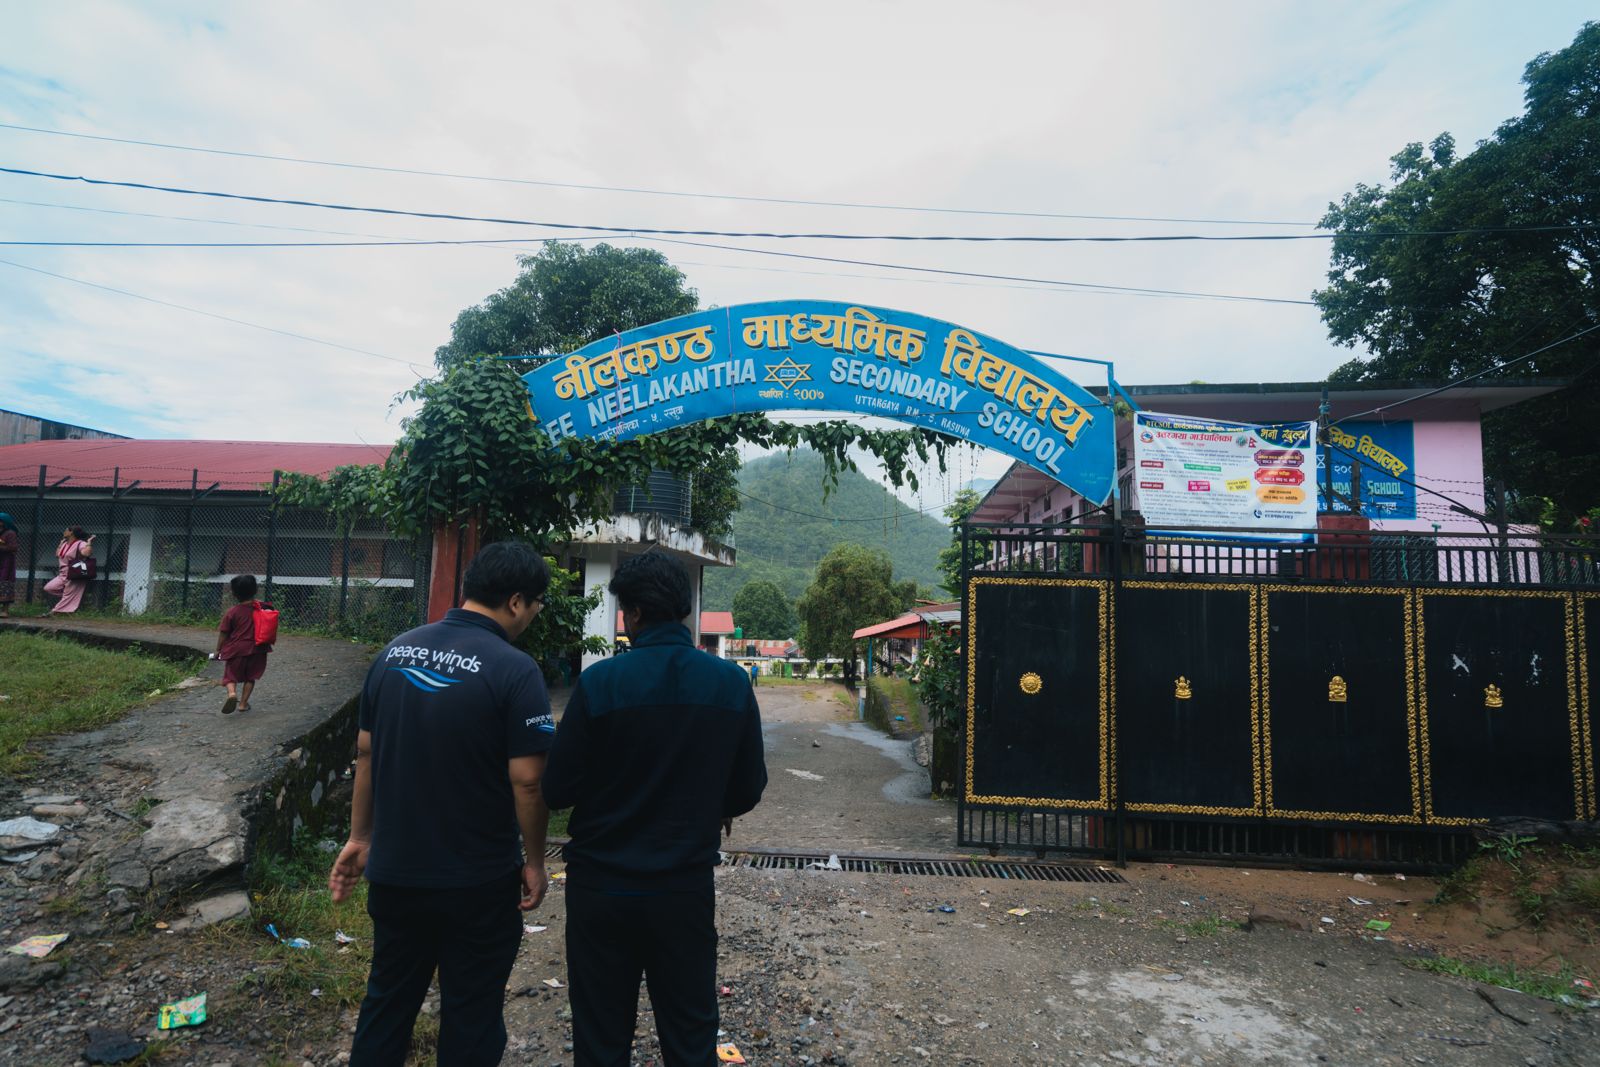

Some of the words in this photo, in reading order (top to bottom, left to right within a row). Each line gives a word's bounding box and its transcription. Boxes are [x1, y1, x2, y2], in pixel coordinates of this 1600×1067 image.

[552, 325, 714, 401] नीलकण्ठ
[742, 306, 927, 363] माध्यमिक
[943, 328, 1094, 443] विद्यालय
[587, 358, 757, 428] NEELAKANTHA
[829, 356, 968, 412] SECONDARY
[977, 401, 1067, 475] SCHOOL
[855, 394, 900, 414] UTTARGAYA
[940, 417, 971, 438] RASUWA
[1356, 434, 1409, 477] विद्यालय
[1366, 480, 1404, 495] SCHOOL
[385, 645, 429, 662] peace
[432, 649, 482, 673] winds
[398, 658, 456, 674] JAPAN
[525, 714, 546, 727] peace
